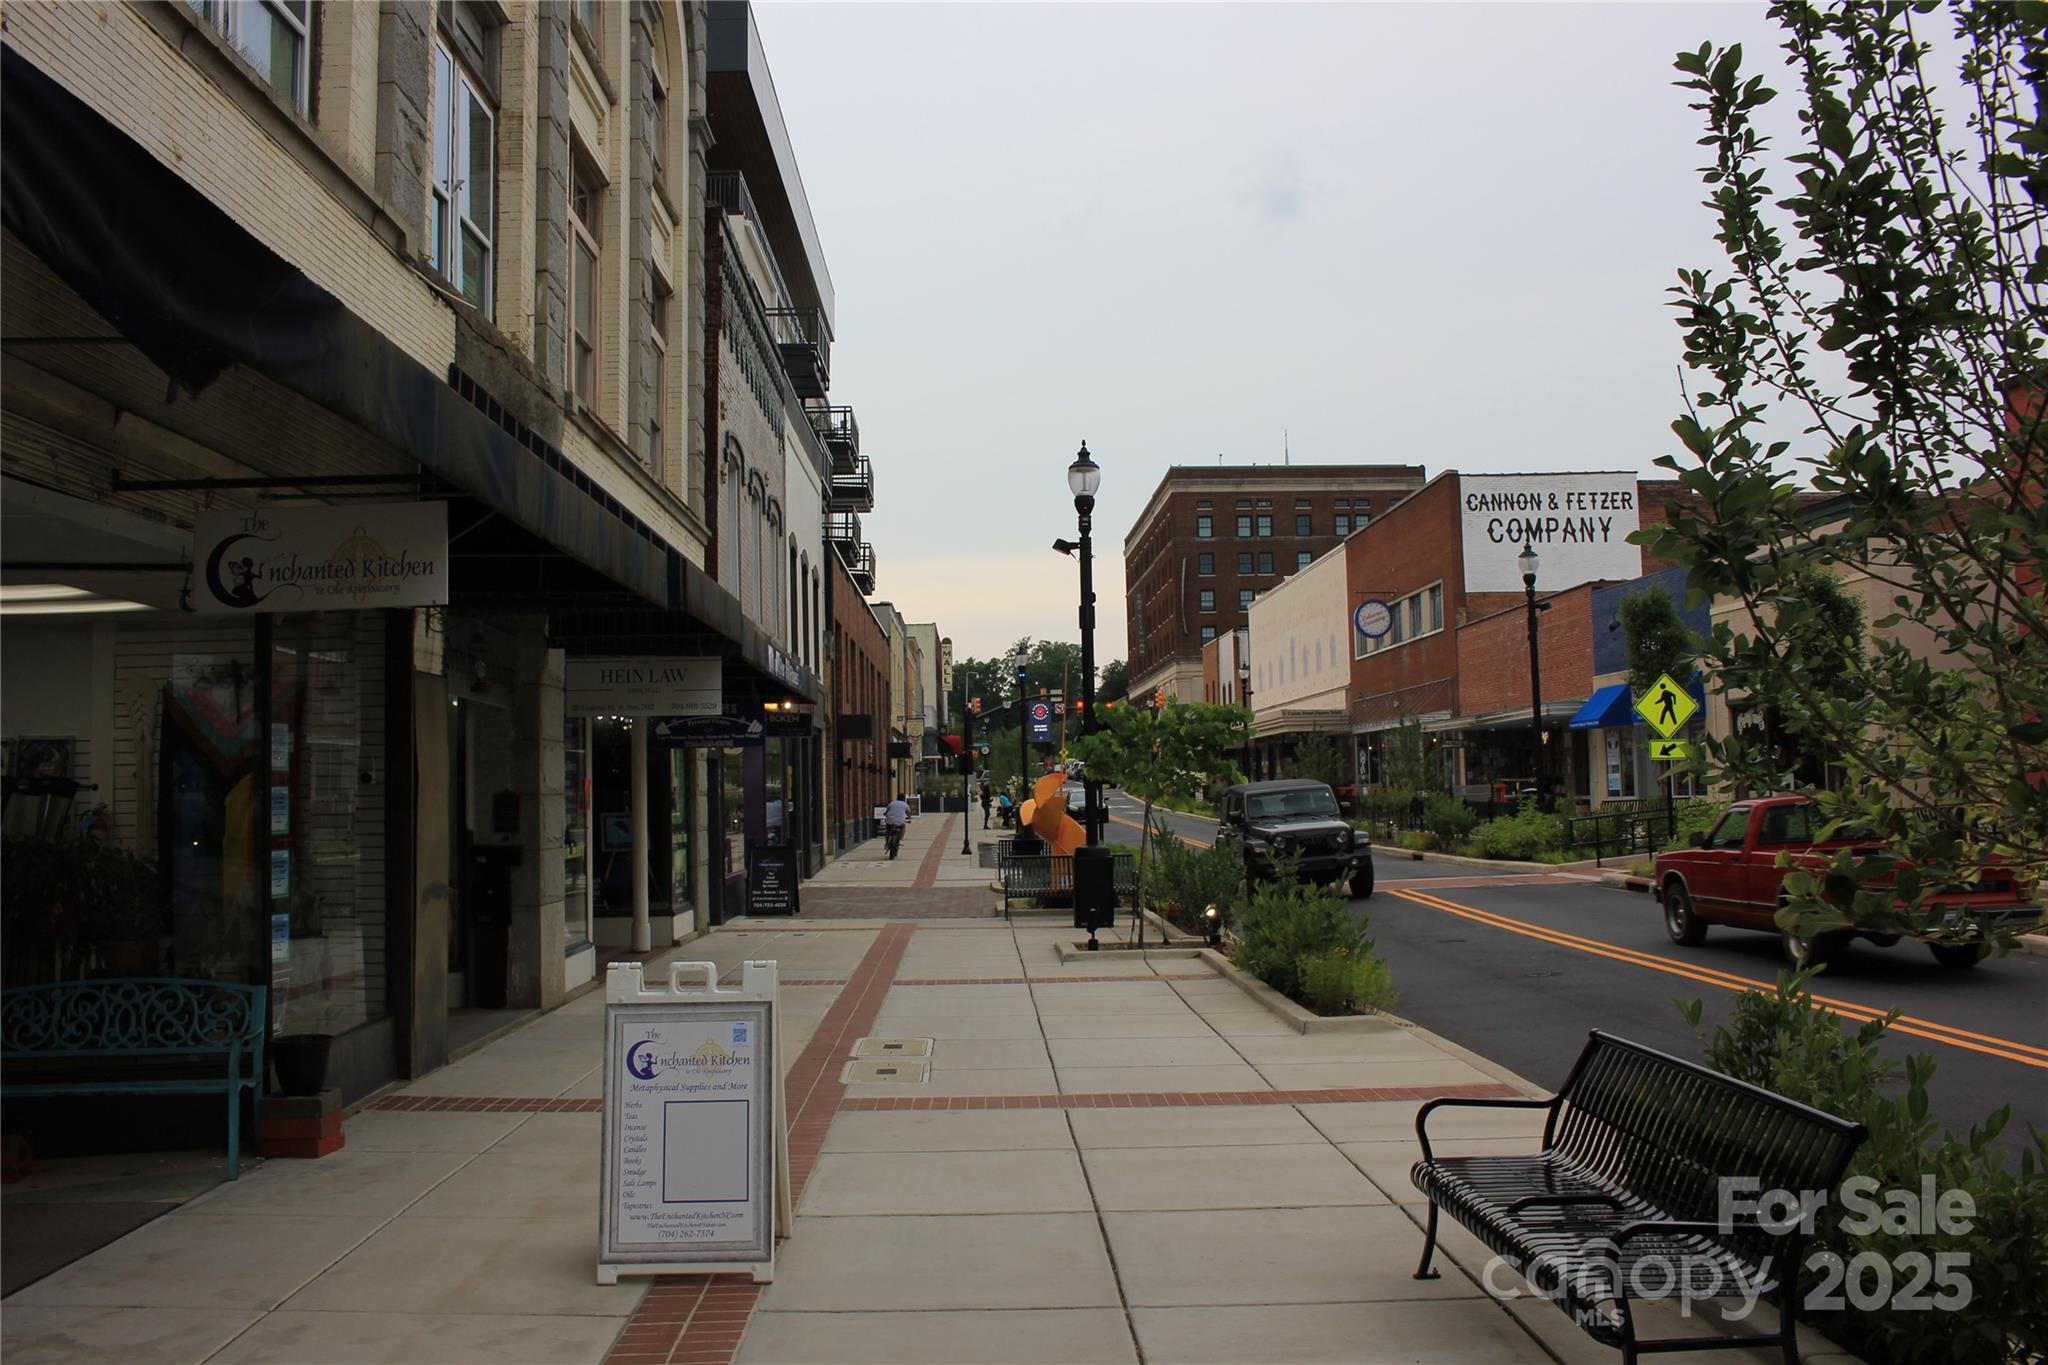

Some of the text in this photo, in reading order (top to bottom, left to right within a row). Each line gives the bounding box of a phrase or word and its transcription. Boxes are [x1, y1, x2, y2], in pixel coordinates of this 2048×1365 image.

[1465, 491, 1633, 511] CANNON & FETZER
[240, 510, 270, 532] The
[1487, 516, 1612, 543] COMPANY
[362, 549, 435, 580] Kitchen
[943, 651, 951, 684] MALL
[600, 668, 688, 684] HEIN LAW
[645, 1028, 662, 1039] The
[711, 1051, 750, 1066] Kitchen
[630, 1082, 748, 1094] Metaphysical Supplies and More
[624, 1101, 642, 1109] Herbs
[624, 1112, 638, 1120] Teas
[624, 1123, 646, 1131] Incense
[623, 1133, 648, 1143] Crystals
[623, 1144, 647, 1153] Candles
[623, 1156, 642, 1165] Books
[623, 1167, 646, 1177] Smudge
[622, 1179, 657, 1189] Salt Lamps
[622, 1190, 635, 1199] Oils
[623, 1202, 653, 1211] Tapestries
[657, 1230, 679, 1240] (704)
